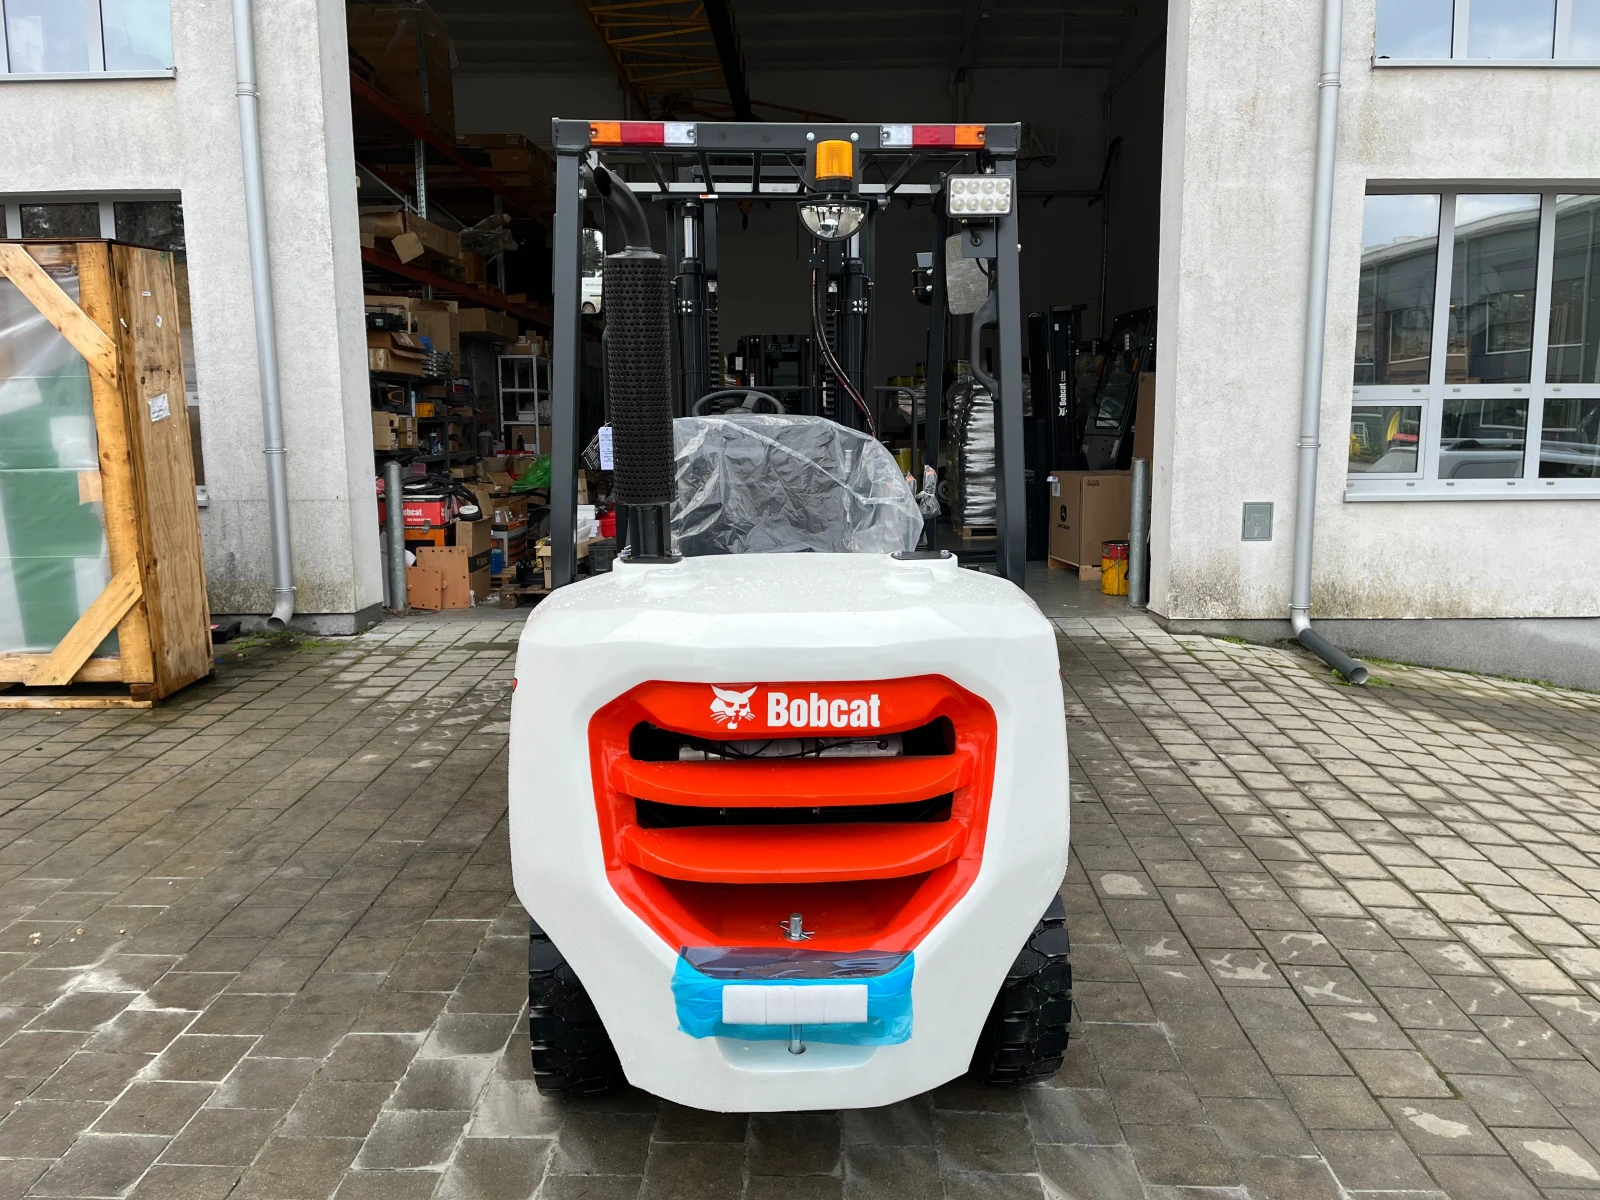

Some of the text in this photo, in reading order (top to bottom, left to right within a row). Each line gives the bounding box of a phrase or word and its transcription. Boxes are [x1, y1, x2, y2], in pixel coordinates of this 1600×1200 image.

[1059, 383, 1067, 406] Bobcat
[402, 508, 422, 516] obcat
[767, 692, 881, 728] Bobcat
